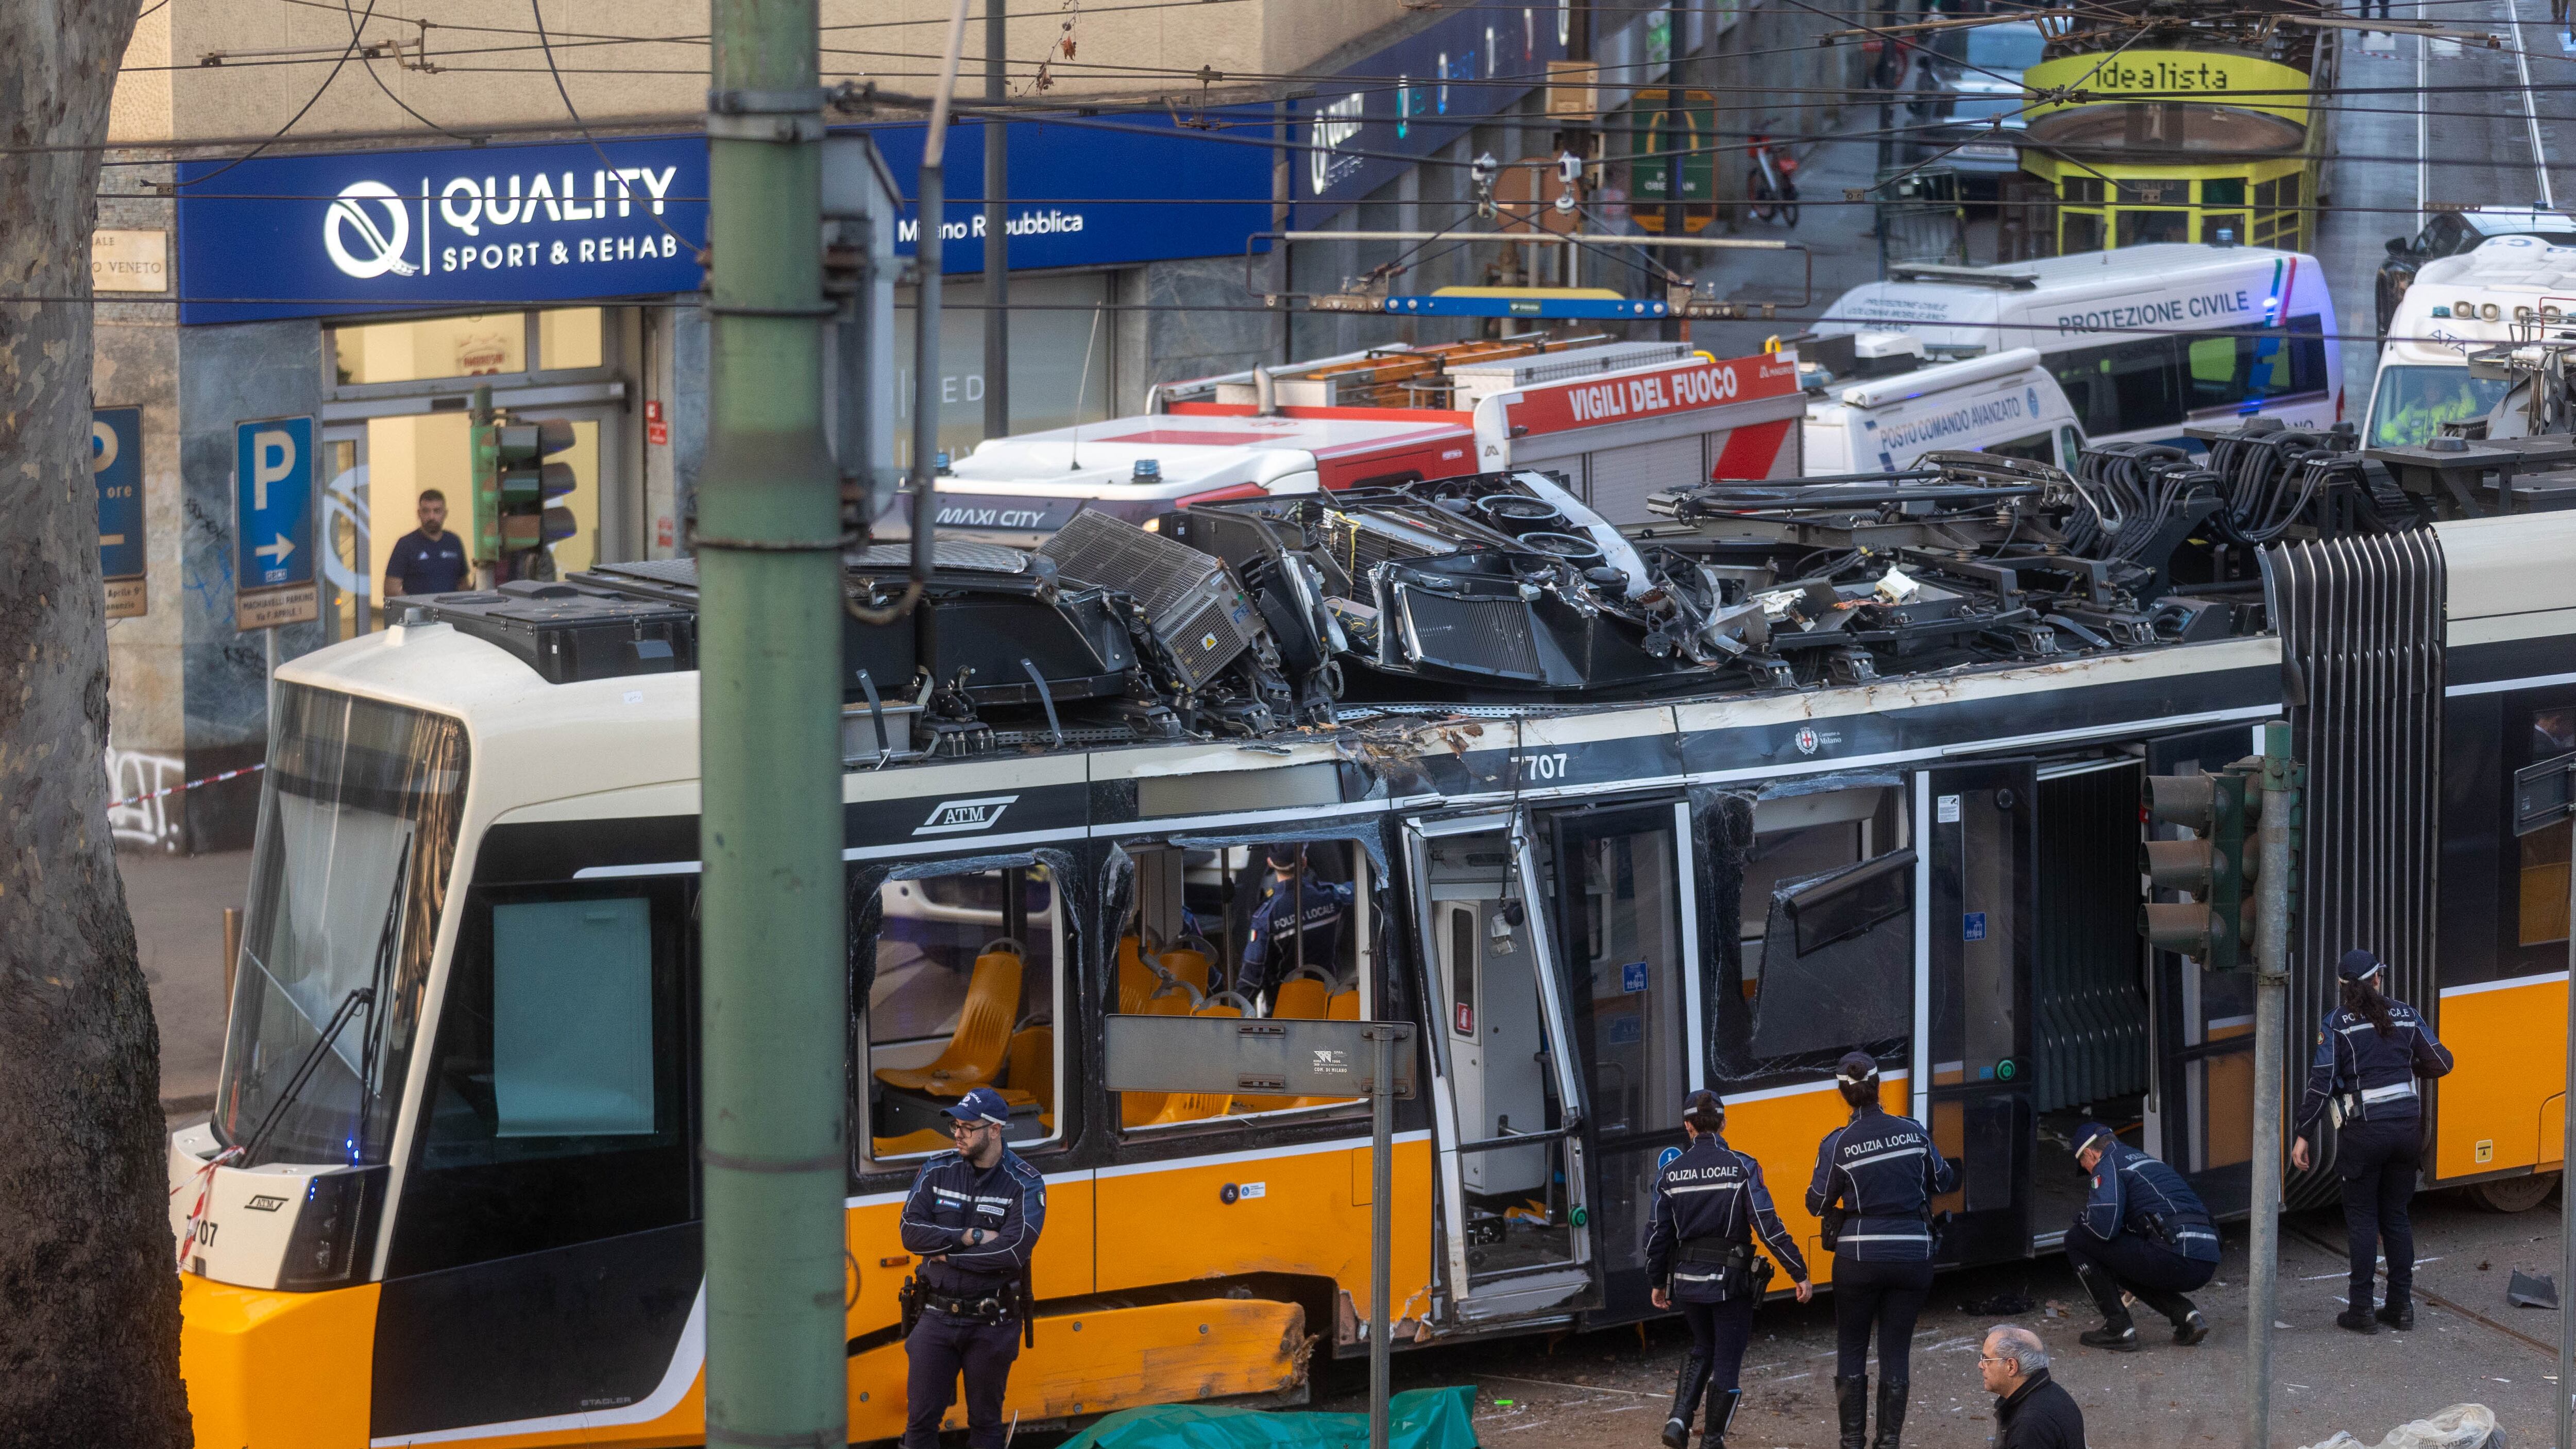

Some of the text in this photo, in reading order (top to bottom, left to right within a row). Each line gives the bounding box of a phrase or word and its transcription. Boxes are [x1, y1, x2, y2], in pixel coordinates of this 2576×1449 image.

[2096, 61, 2227, 89] idealista
[440, 166, 677, 236] QUALITY
[899, 209, 1083, 242] Mino Rubblica
[442, 233, 677, 271] SPORT & REHAB
[109, 262, 161, 273] VENETO
[2058, 291, 2249, 337] PROTEZIONE CIVILE
[1568, 366, 1737, 421] VIGILI DEL FUOCO
[1880, 397, 2021, 450] POSTO COMANDO AVANZATO
[254, 431, 296, 510] P
[936, 507, 1046, 527] MAXI CITY
[286, 593, 314, 603] PARKING
[943, 806, 985, 824] ATM
[1274, 903, 1335, 929] POLIZA LOCALE
[2387, 1008, 2410, 1017] CALE
[1844, 1133, 1921, 1157] POLIZIA LOCALE
[1666, 1166, 1738, 1183] POLIZIA LOCALE
[257, 1199, 274, 1208] ATM
[187, 1215, 218, 1247] 707
[581, 1397, 631, 1406] STADLER
